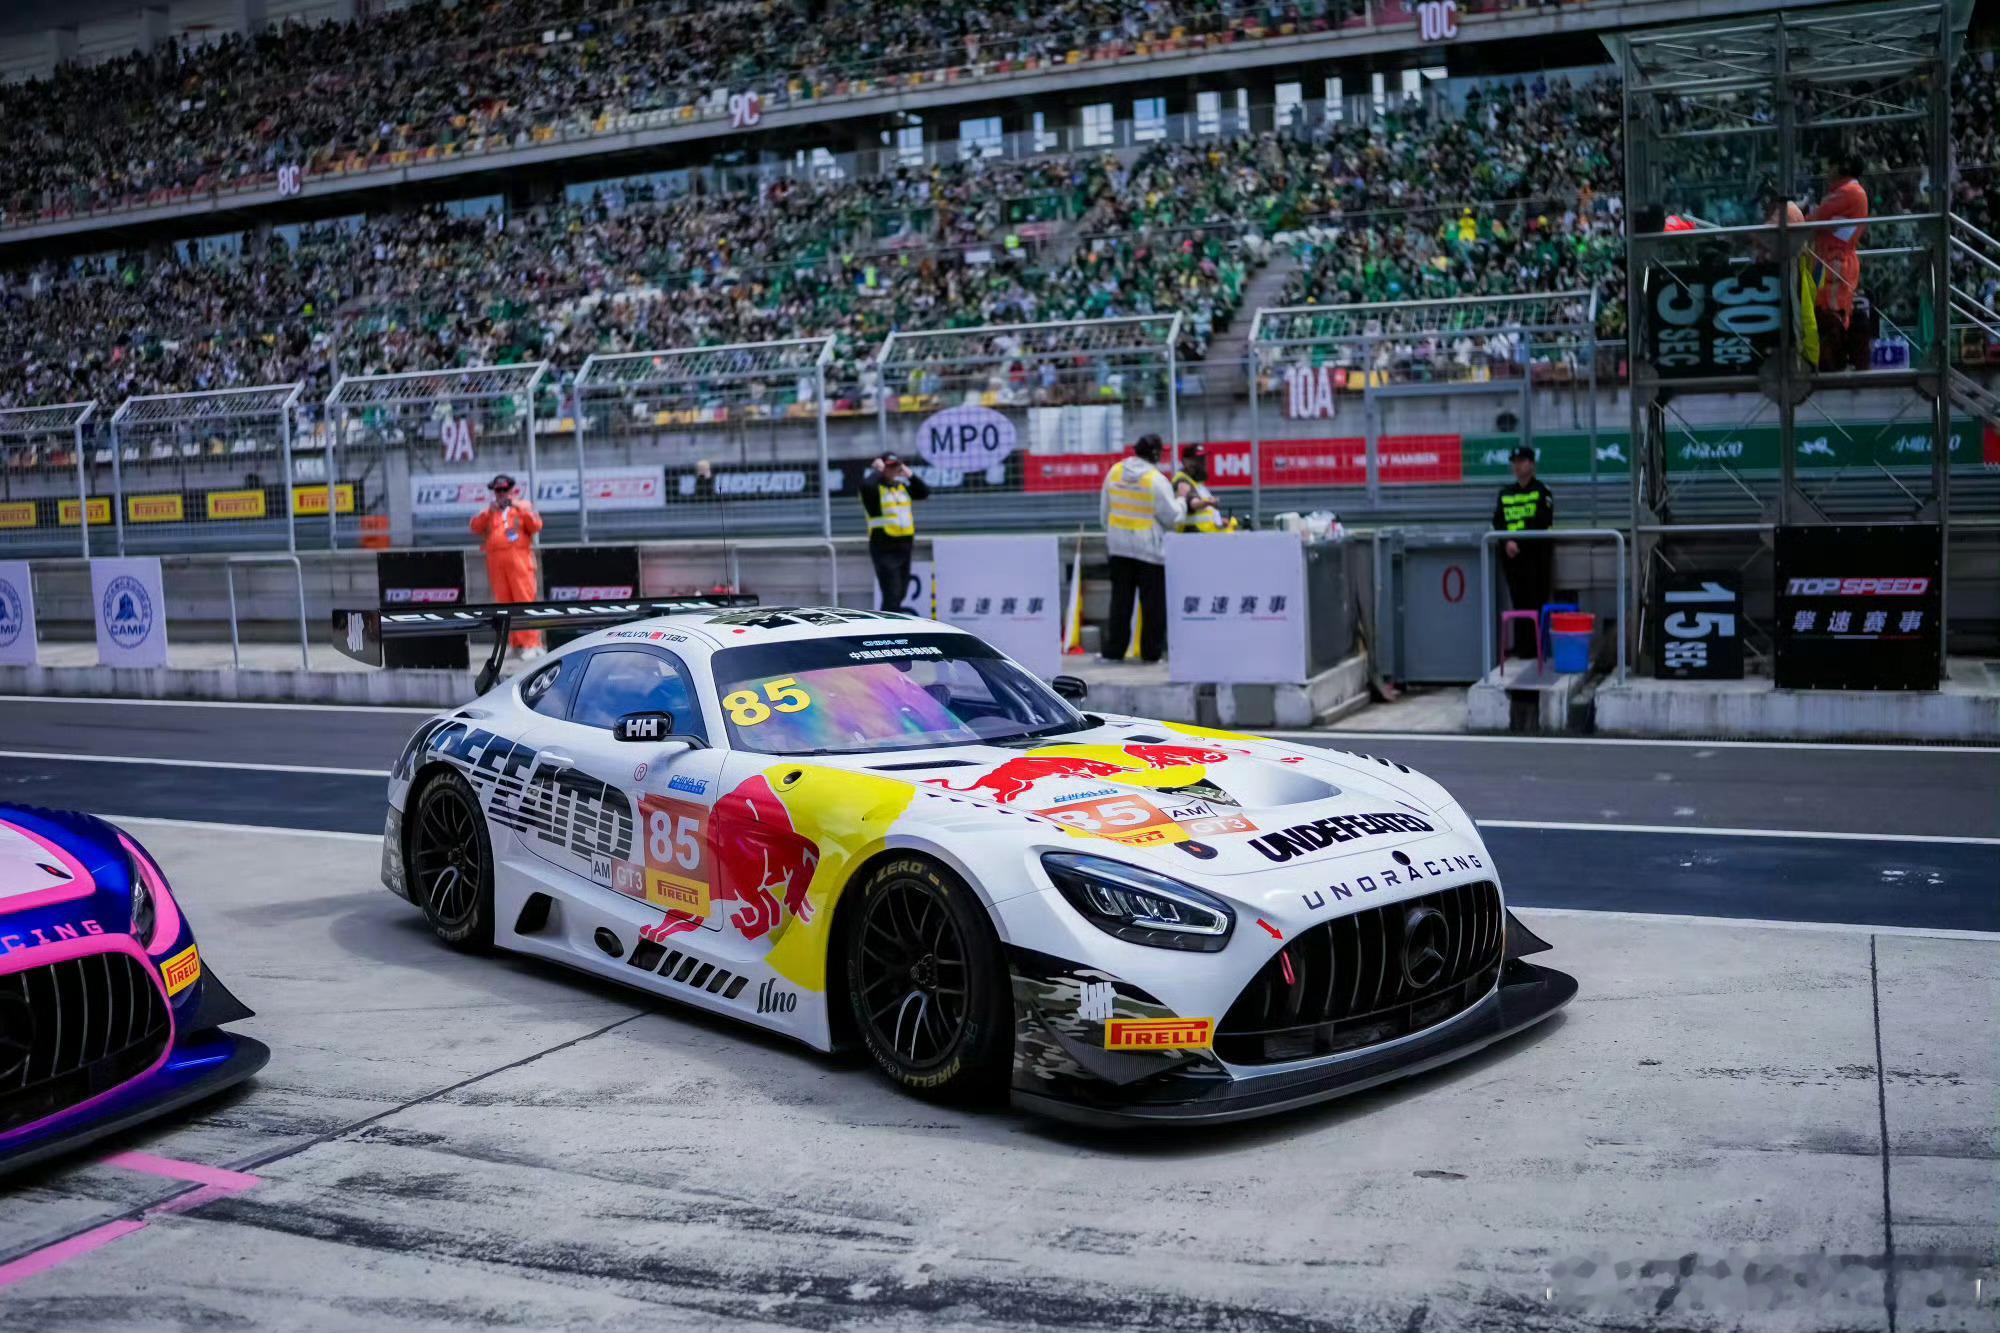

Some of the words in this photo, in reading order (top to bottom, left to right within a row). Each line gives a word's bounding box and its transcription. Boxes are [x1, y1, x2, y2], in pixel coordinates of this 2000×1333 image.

[1417, 0, 1457, 40] 10C
[729, 91, 759, 128] 9C
[279, 165, 300, 196] 8C
[1712, 276, 1781, 334] 30
[1658, 328, 1700, 367] SEC
[1713, 336, 1751, 365] SEC
[1284, 366, 1335, 417] 10A
[441, 418, 475, 462] 9A
[1214, 453, 1250, 476] HH
[64, 504, 105, 520] PIRLLI
[135, 502, 176, 517] PIRELLI
[214, 497, 258, 513] PIRELLI
[299, 492, 345, 508] PIRELI
[1789, 577, 1839, 595] TOP
[1839, 577, 1929, 595] SPEED
[1664, 581, 1736, 638] 15
[111, 624, 146, 636] CAMP
[1664, 640, 1708, 668] SEC
[723, 677, 811, 727] 85
[626, 718, 658, 737] HH
[1047, 800, 1151, 831] 85
[1172, 804, 1208, 819] AM
[650, 810, 700, 870] 85
[1191, 817, 1248, 835] GT3
[1247, 812, 1436, 863] UNDEFEATED
[593, 863, 611, 878] AM
[616, 866, 643, 891] GT3
[876, 860, 924, 884] ZERO
[1302, 854, 1483, 910] UNORACING
[657, 879, 699, 905] PIRELLI
[167, 952, 198, 988] PIRELLI
[1110, 1021, 1209, 1045] PIRELLI
[902, 1056, 961, 1088] PIRELLI
